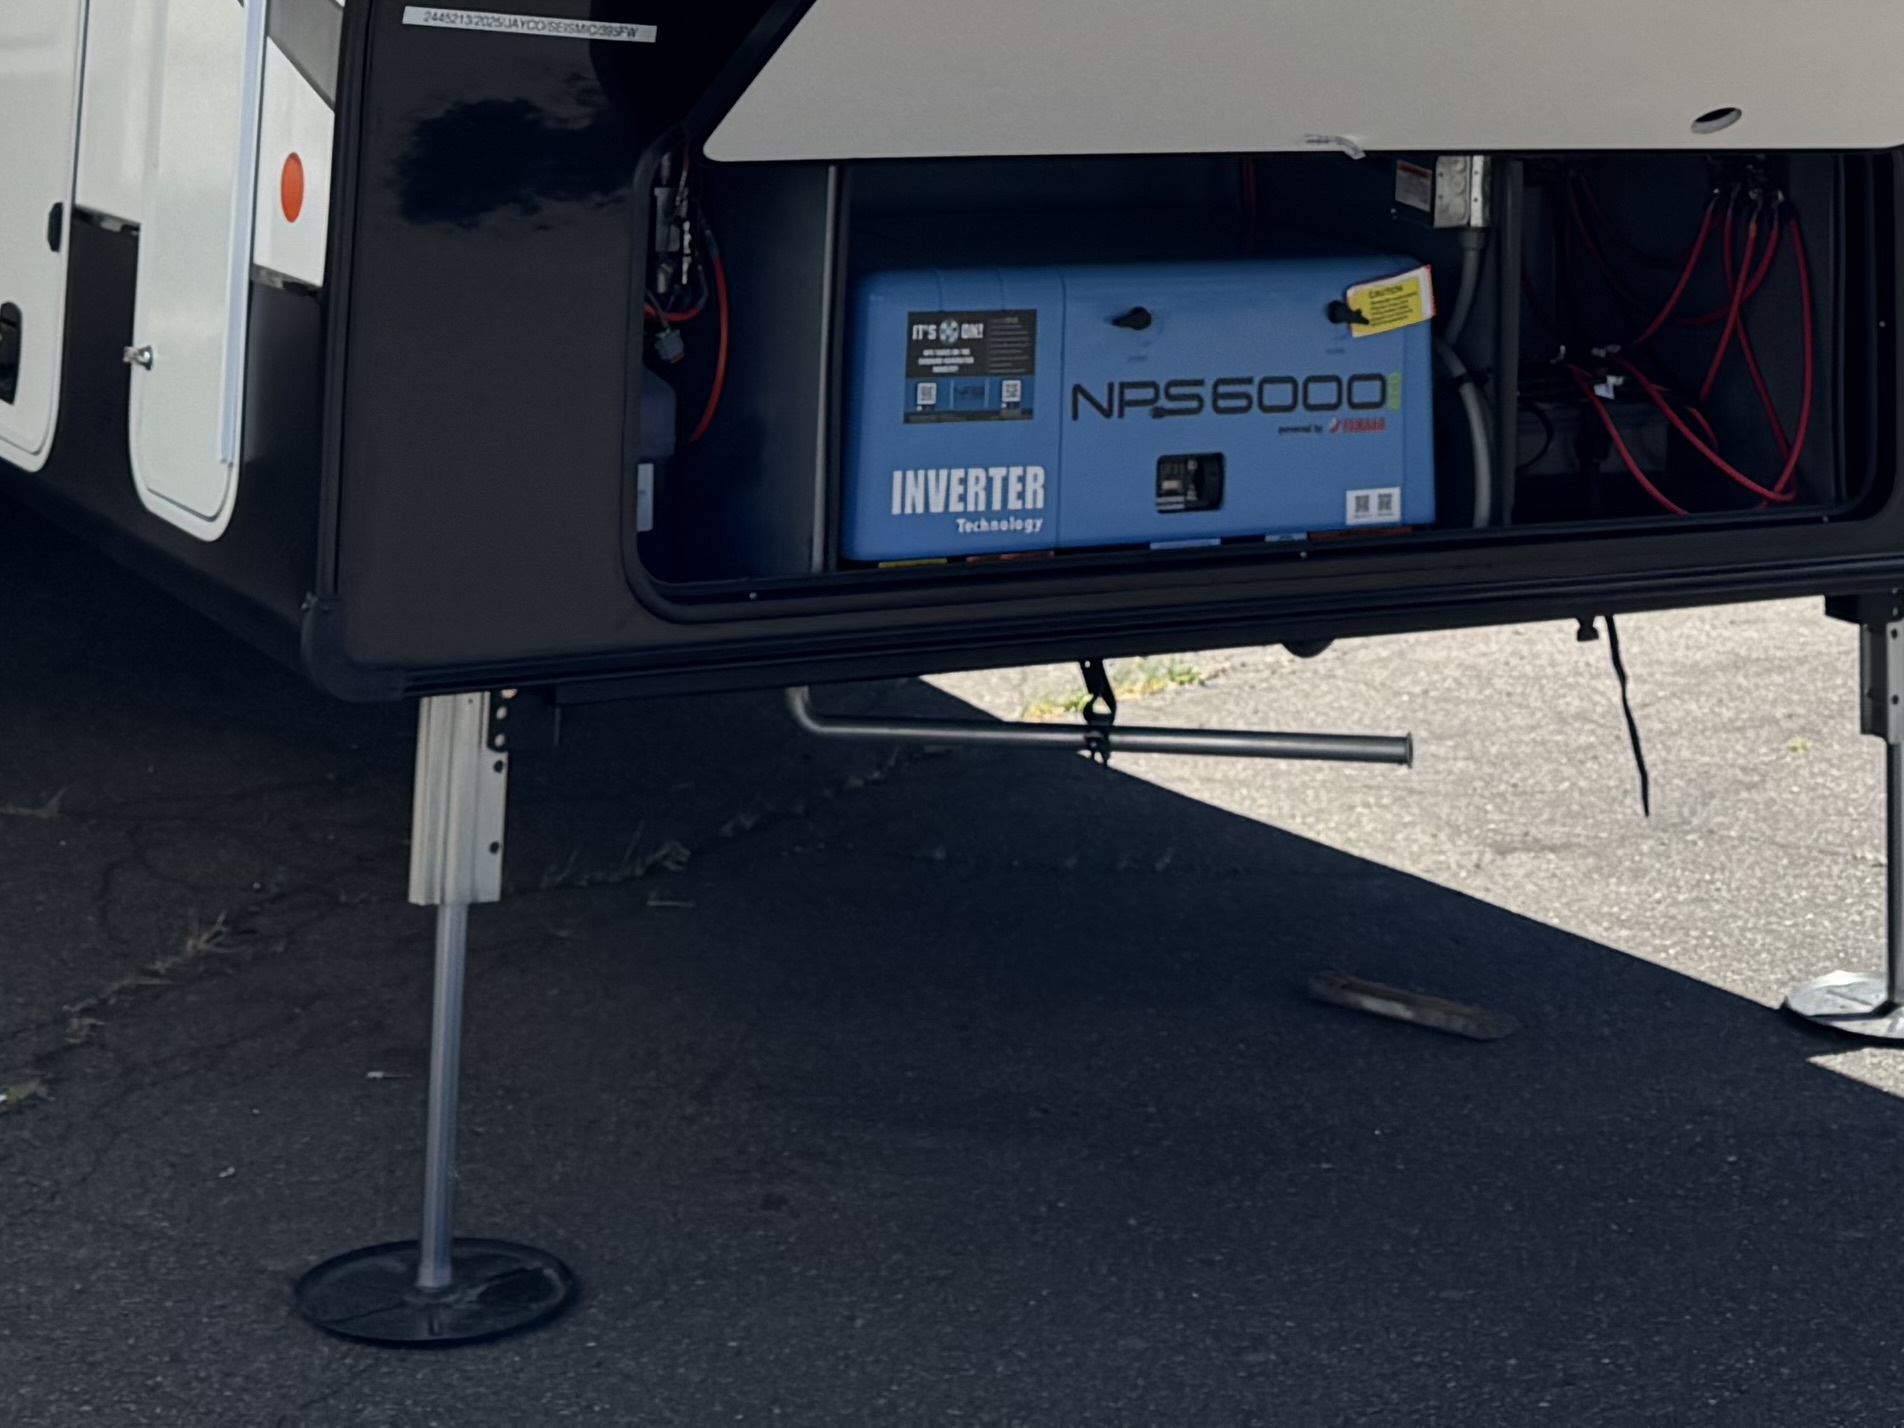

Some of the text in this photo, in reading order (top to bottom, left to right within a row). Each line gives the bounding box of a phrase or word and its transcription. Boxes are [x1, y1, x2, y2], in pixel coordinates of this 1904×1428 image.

[1071, 373, 1387, 421] NPS6000
[891, 465, 1046, 515] INVERTER
[956, 516, 1044, 534] Technology
